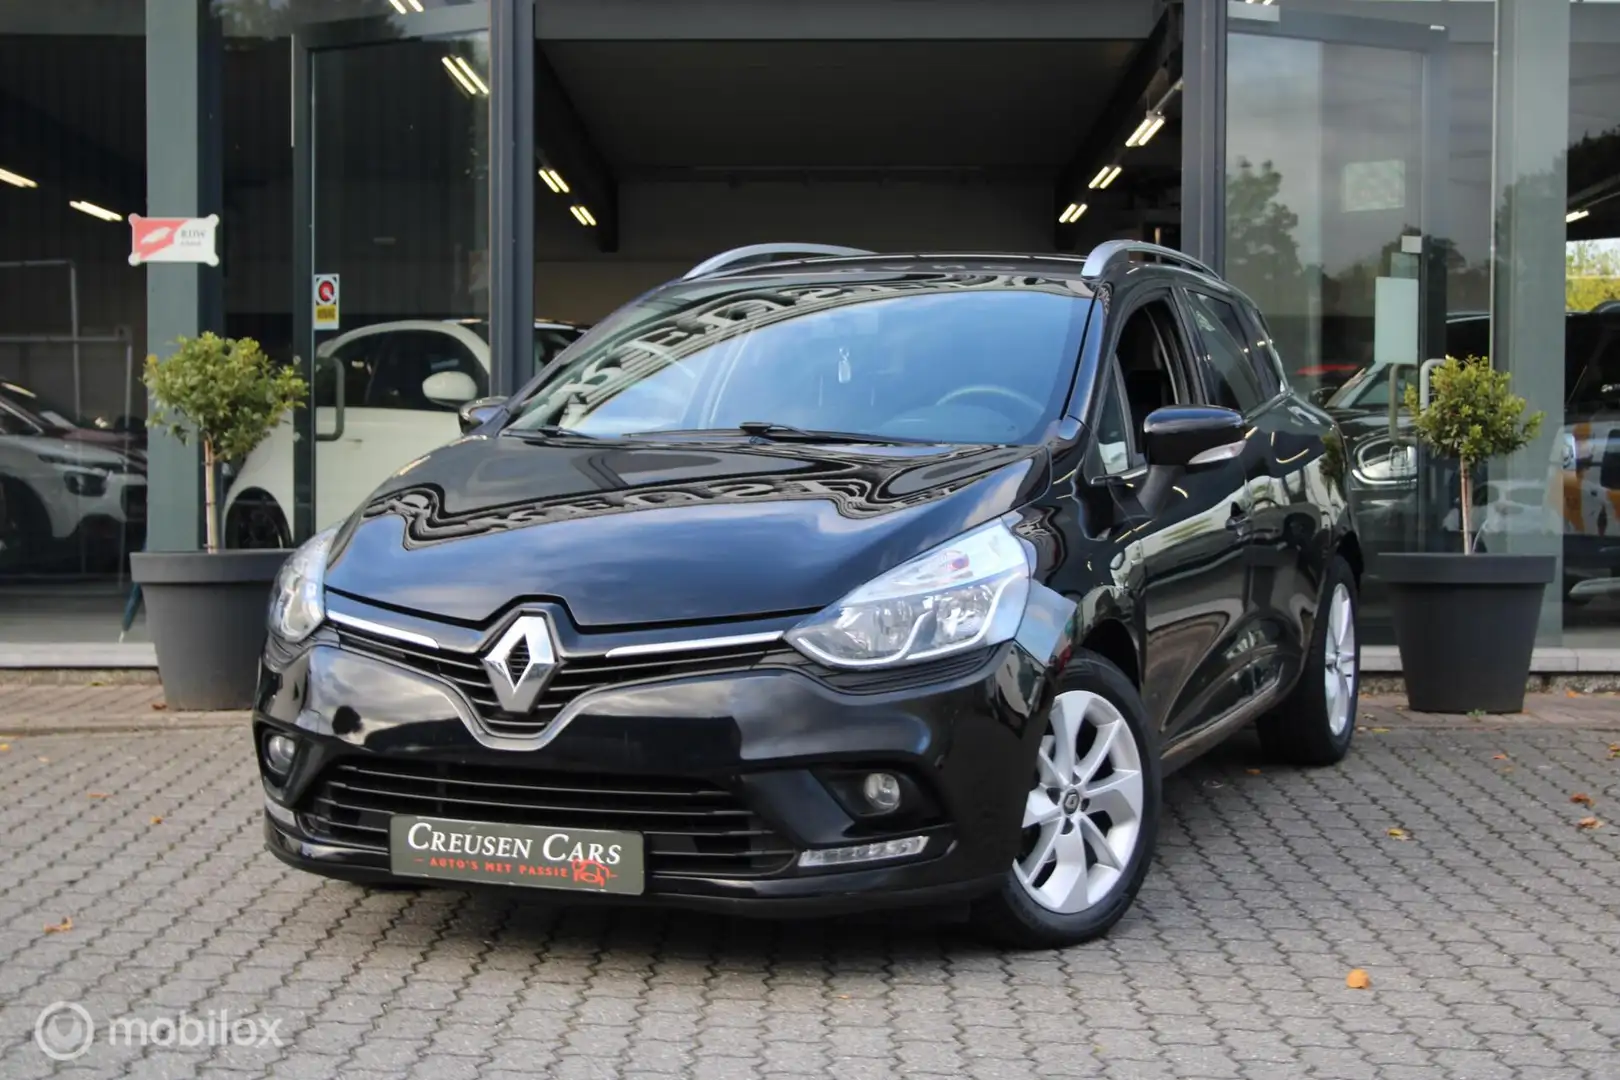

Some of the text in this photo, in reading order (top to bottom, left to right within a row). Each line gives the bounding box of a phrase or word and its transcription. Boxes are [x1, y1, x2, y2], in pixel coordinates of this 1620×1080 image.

[407, 822, 622, 864] CREUSEN CARS
[430, 856, 569, 879] AUTO'S MET PASSIE
